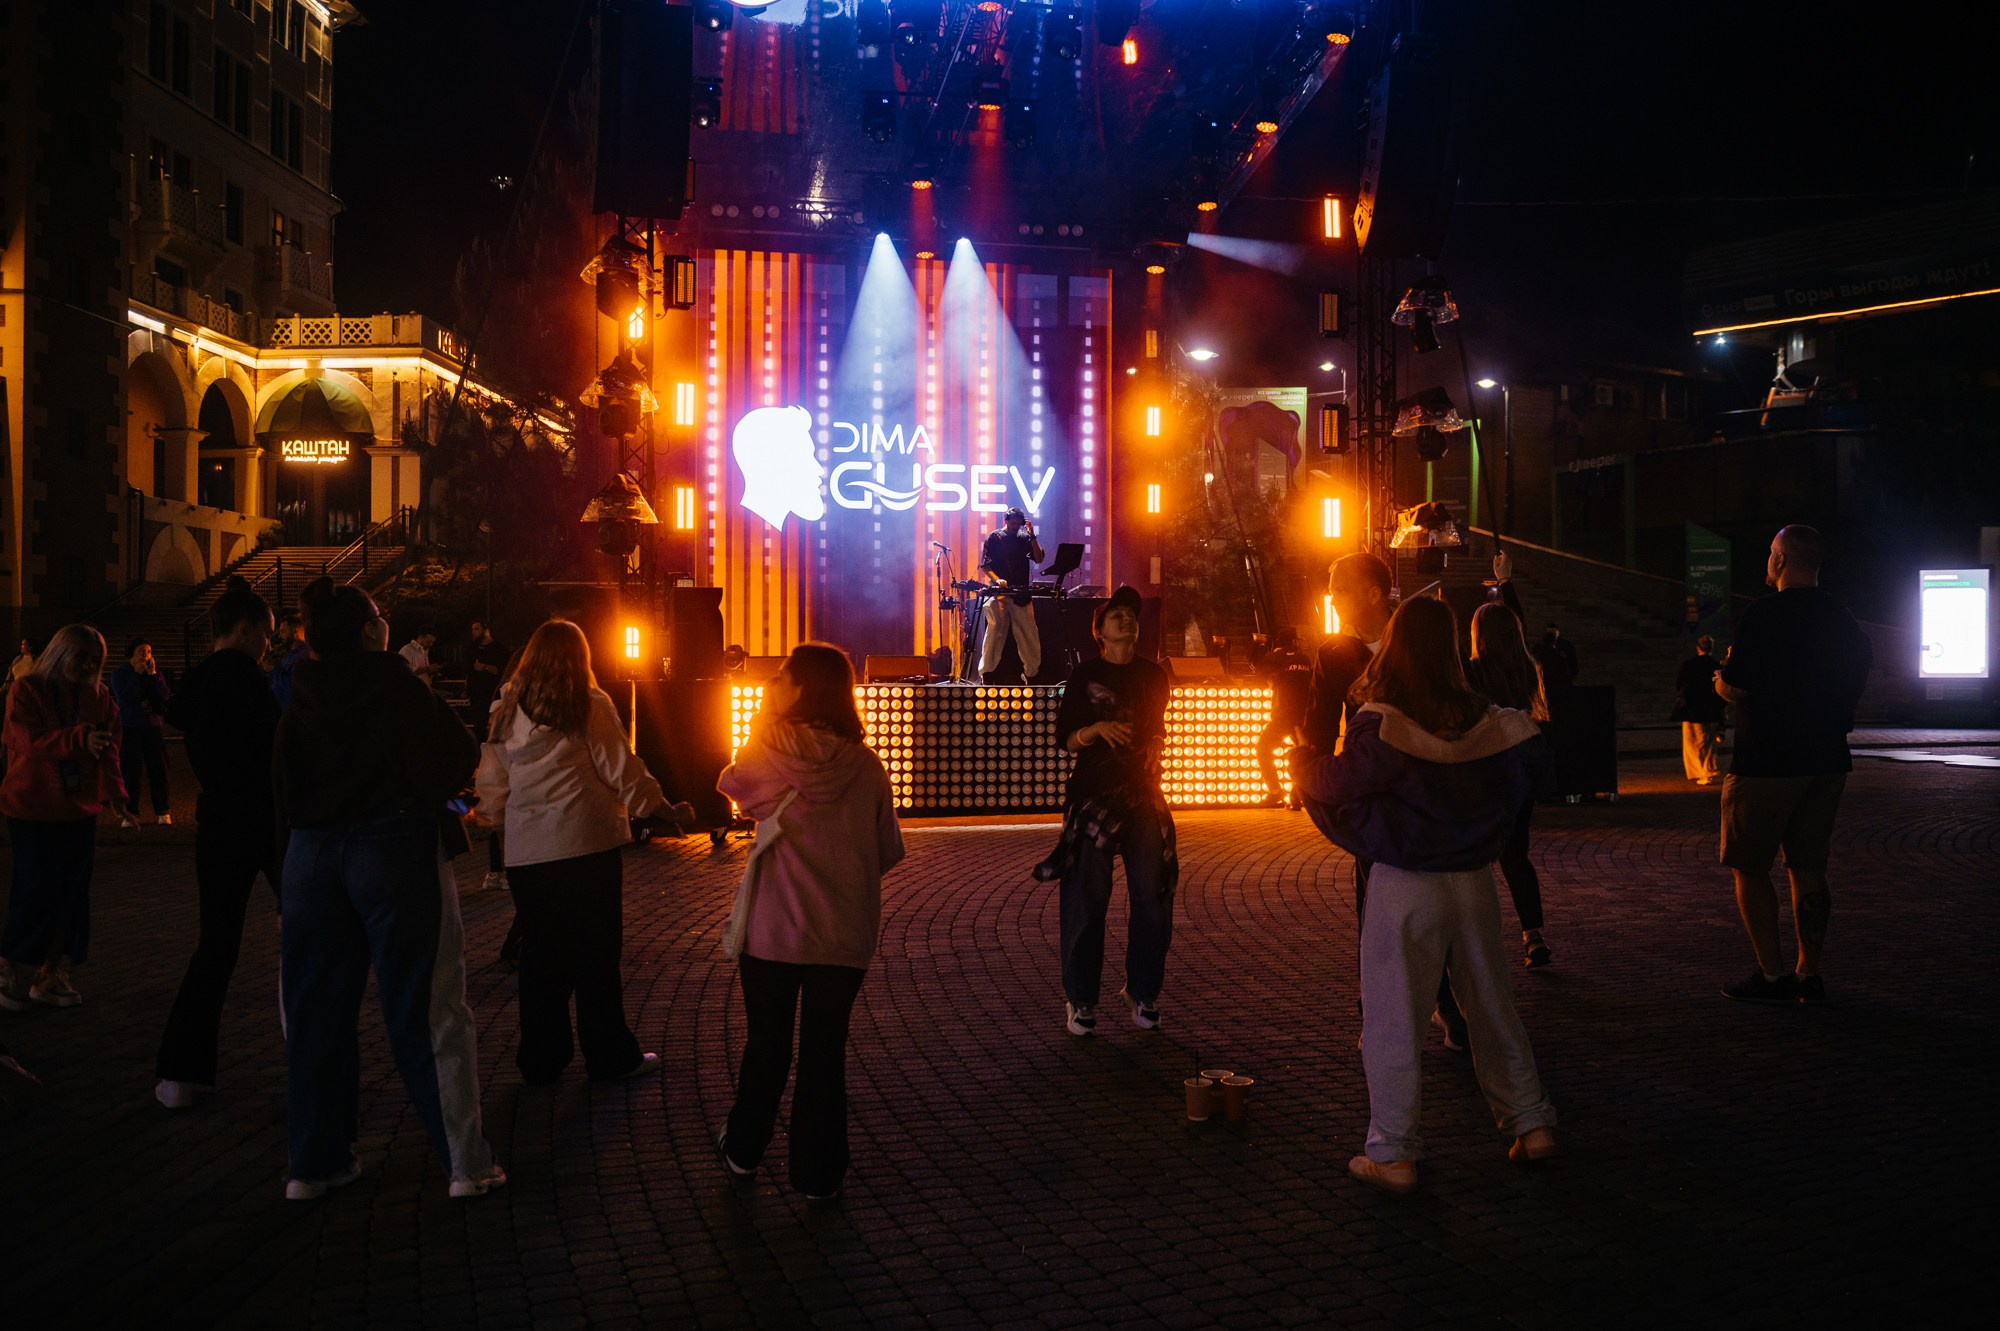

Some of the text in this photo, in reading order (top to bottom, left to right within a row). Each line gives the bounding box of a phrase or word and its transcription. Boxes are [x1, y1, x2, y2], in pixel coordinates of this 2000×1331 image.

[1784, 287, 1835, 307] Горы
[1839, 273, 1920, 298] выгоды
[1925, 257, 1992, 285] ждут!
[281, 439, 350, 455] КАШТАН
[833, 421, 936, 456] DIMA
[829, 461, 1056, 515] GUSEV
